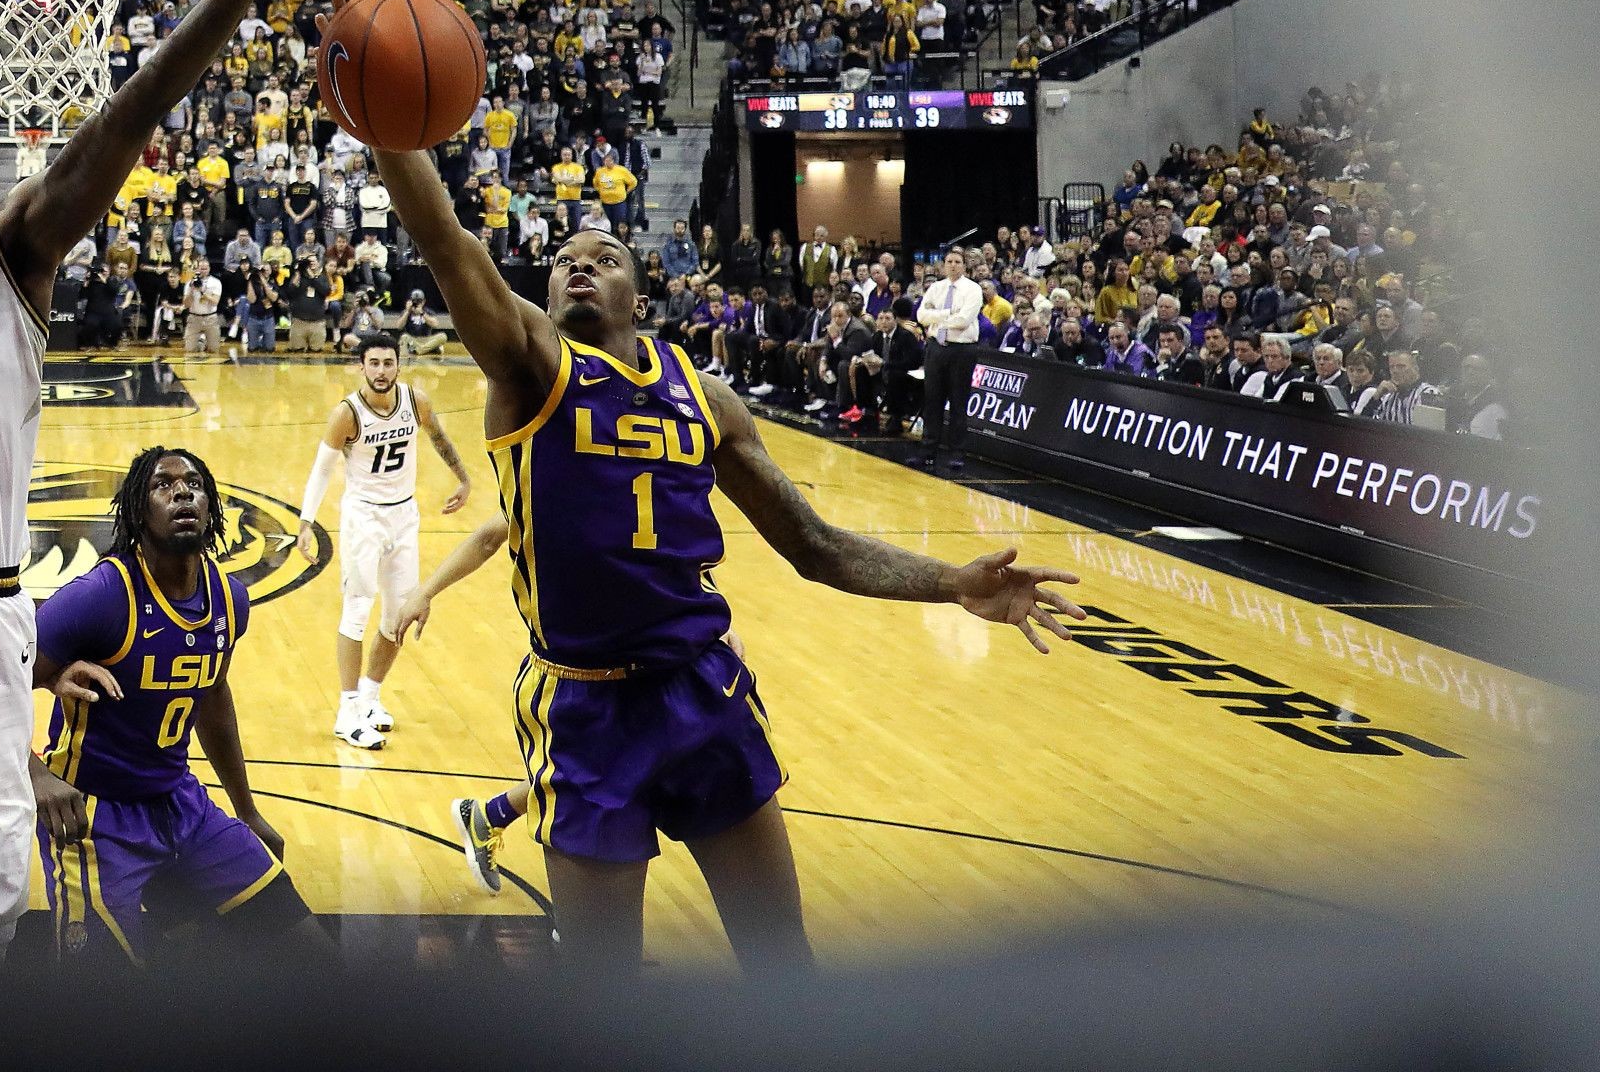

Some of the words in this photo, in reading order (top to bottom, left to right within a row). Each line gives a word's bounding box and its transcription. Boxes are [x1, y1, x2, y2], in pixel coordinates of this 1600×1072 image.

[824, 109, 848, 129] 38
[866, 95, 896, 109] 16:40
[915, 107, 940, 128] 39
[980, 369, 1022, 394] PURINA
[978, 392, 1037, 431] PLAN
[364, 426, 414, 444] MIZZOU
[575, 407, 706, 467] LSU
[371, 440, 409, 474] 15
[1064, 397, 1213, 462] NUTRITION
[1221, 430, 1308, 483] THAT
[1311, 451, 1543, 539] PERFORMS
[632, 472, 658, 549] 1
[140, 651, 224, 690] LSU
[157, 696, 195, 749] 0
